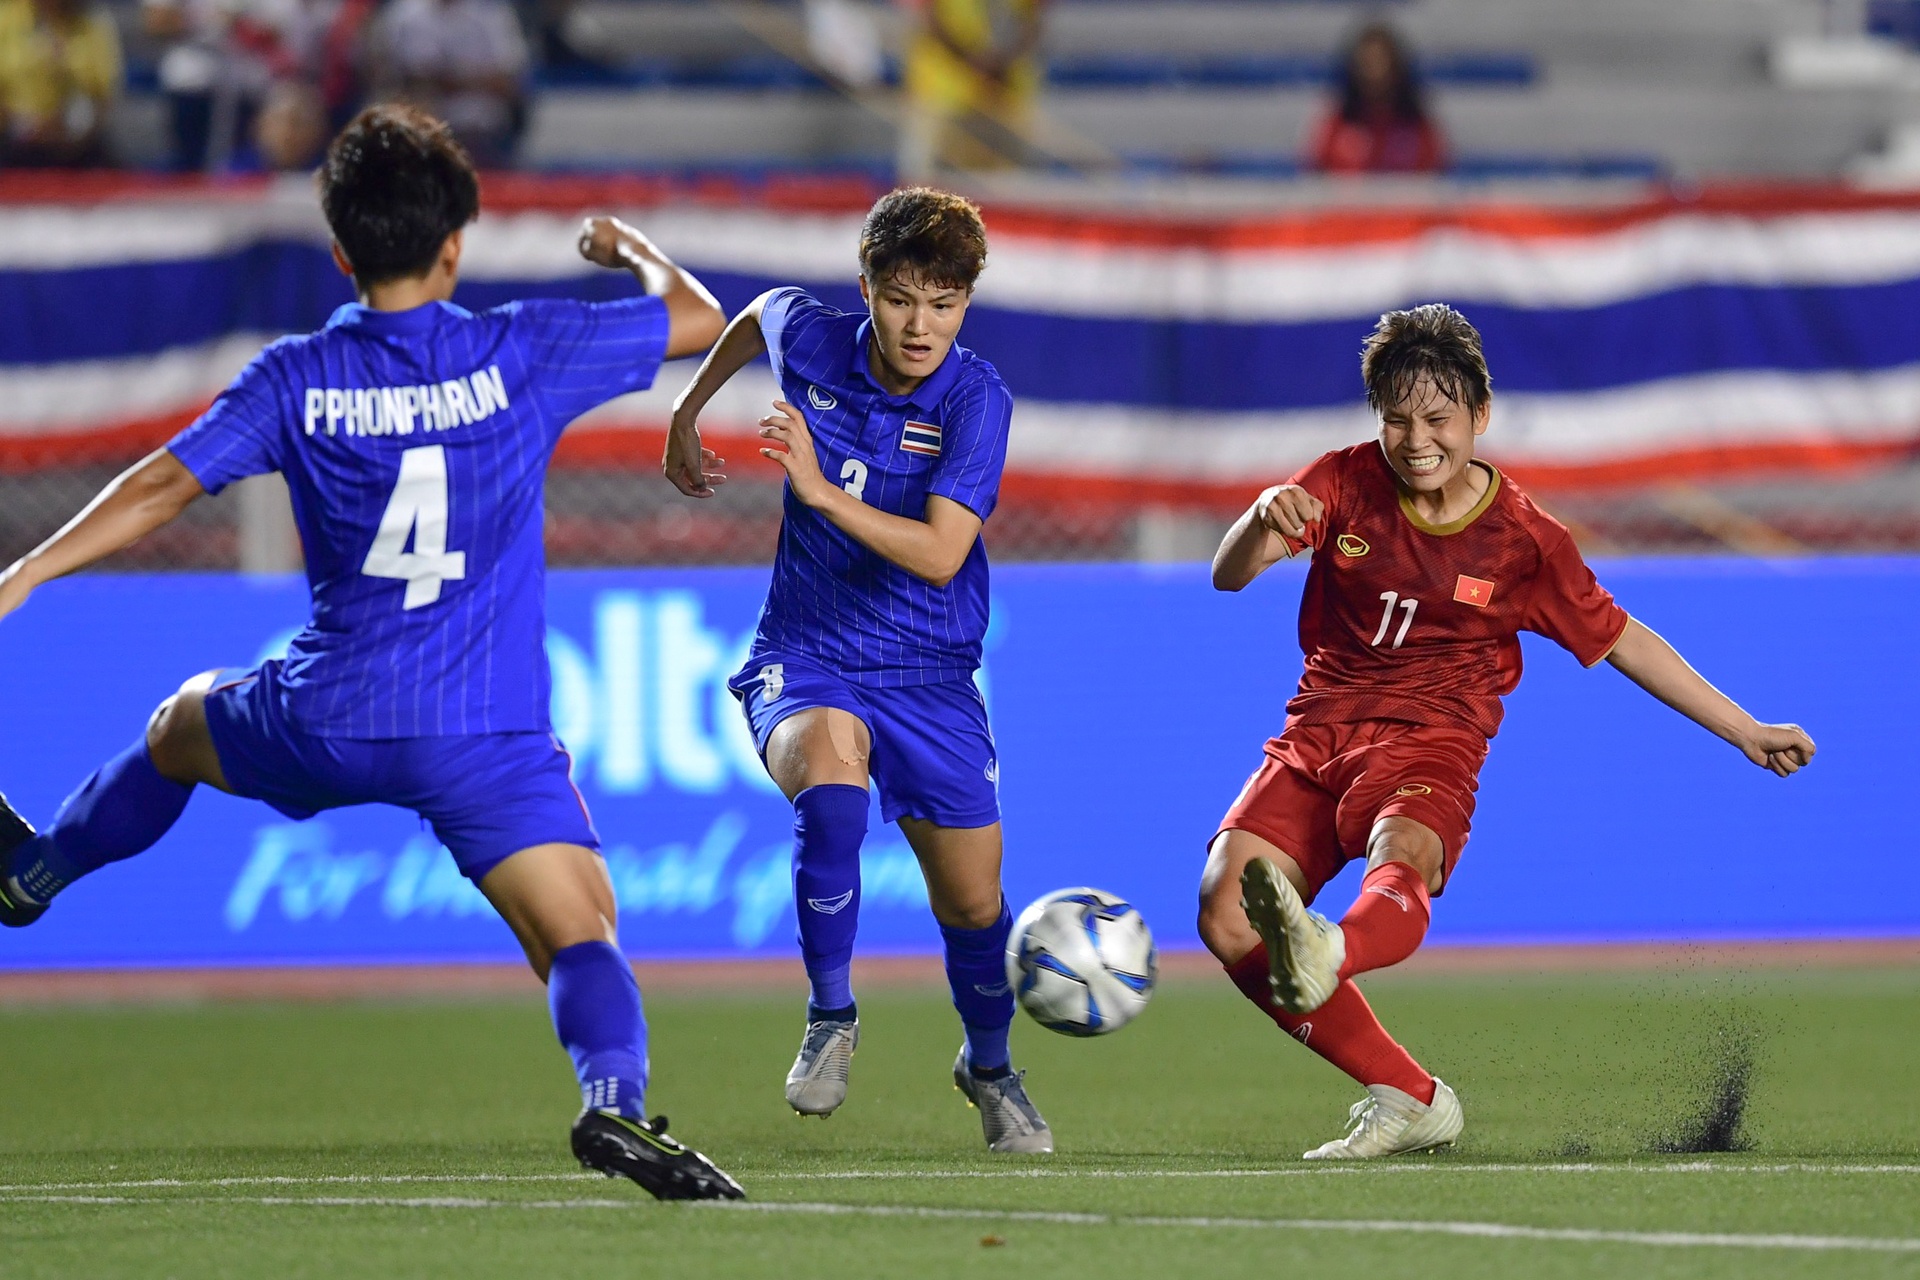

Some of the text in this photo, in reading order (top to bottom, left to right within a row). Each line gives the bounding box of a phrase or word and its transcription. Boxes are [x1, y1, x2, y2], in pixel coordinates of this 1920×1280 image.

[840, 458, 868, 501] 3
[361, 444, 466, 610] 4
[1371, 590, 1419, 650] 11
